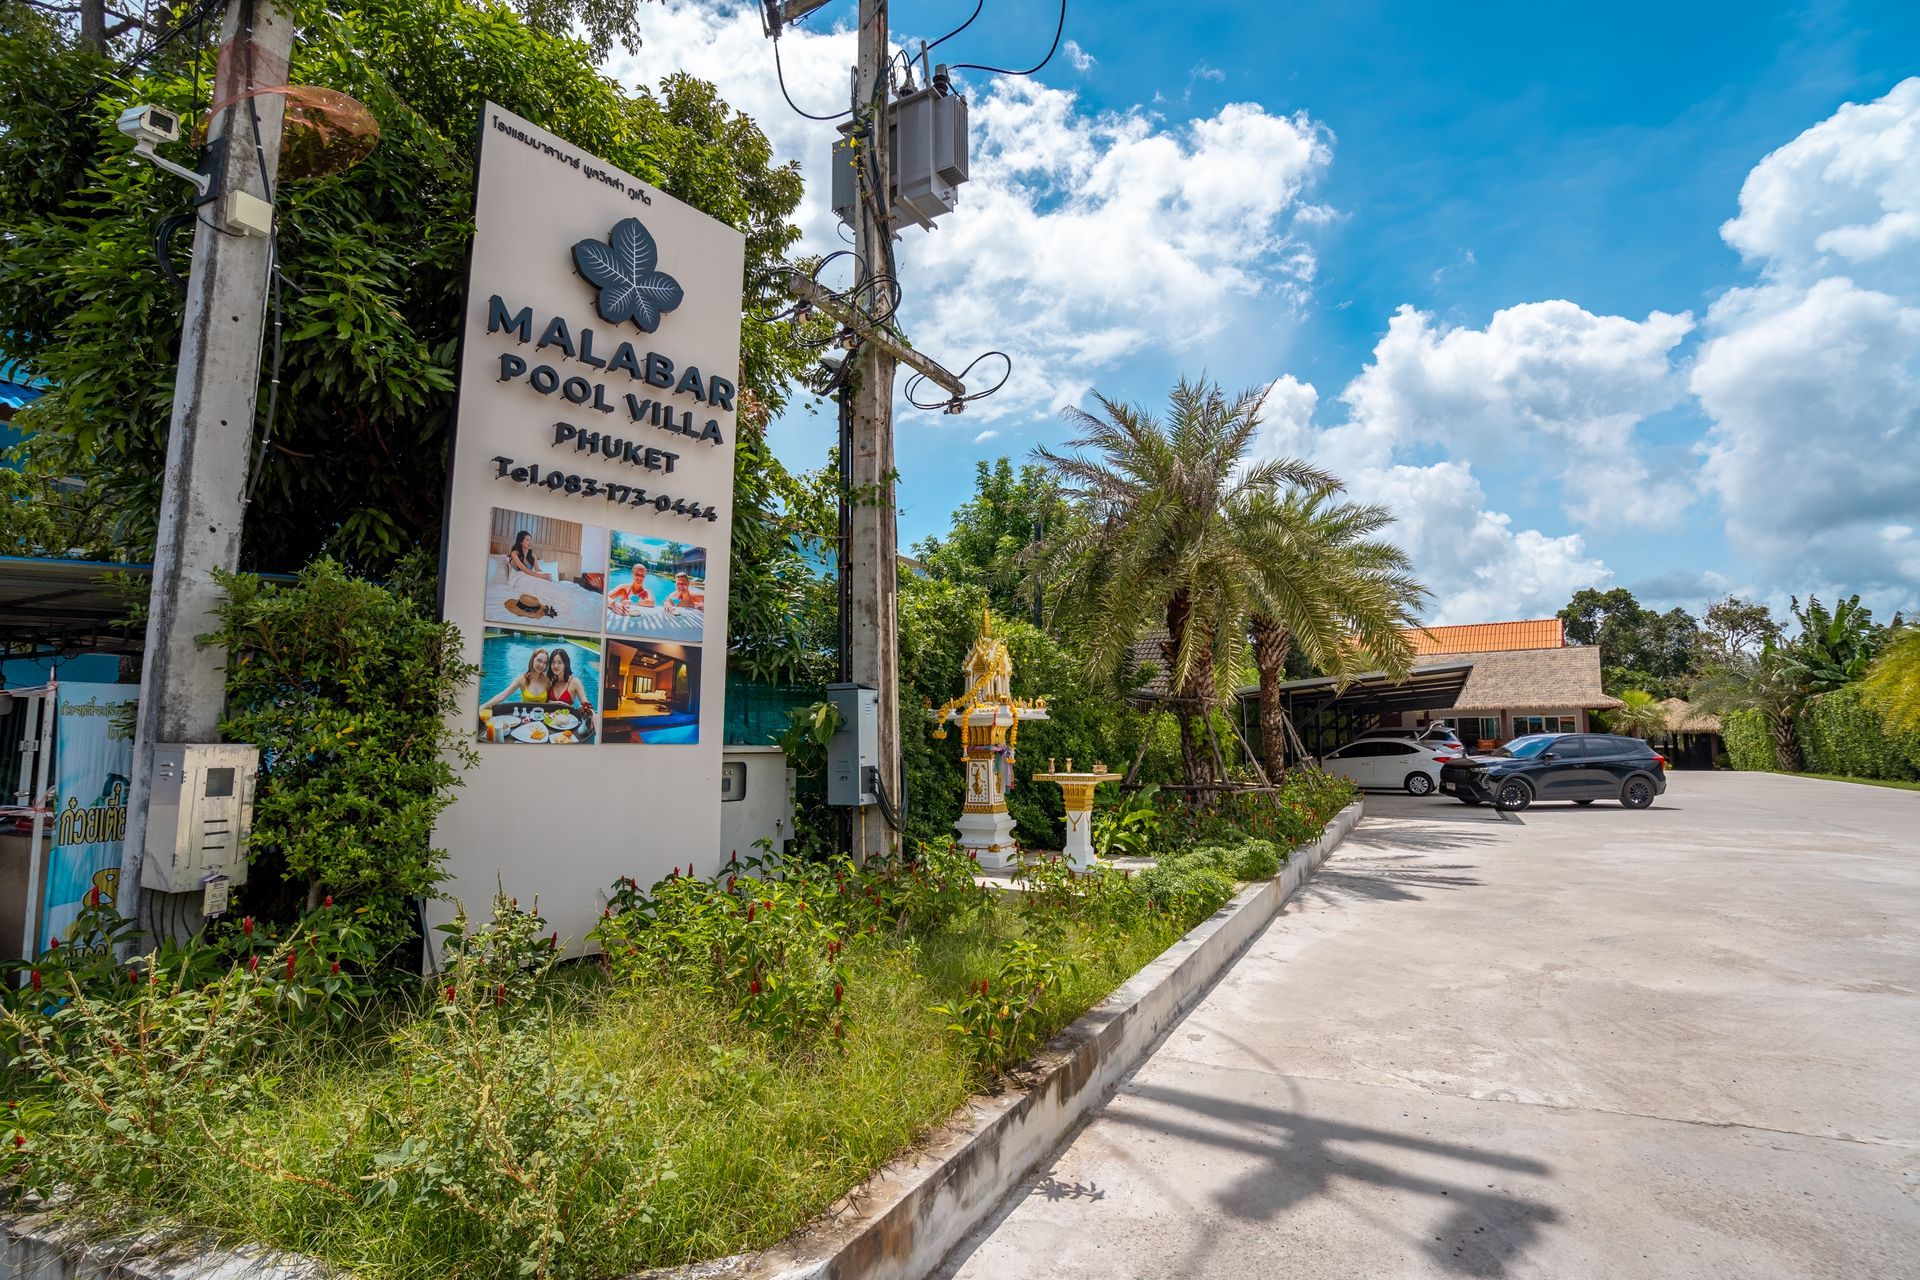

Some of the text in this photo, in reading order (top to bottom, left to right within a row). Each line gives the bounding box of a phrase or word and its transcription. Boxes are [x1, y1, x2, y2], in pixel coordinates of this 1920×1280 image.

[627, 187, 651, 206] ภูเก็ต
[488, 294, 735, 412] MALABAR
[500, 352, 724, 446] POOL VILLA
[554, 421, 680, 474] PHUKET
